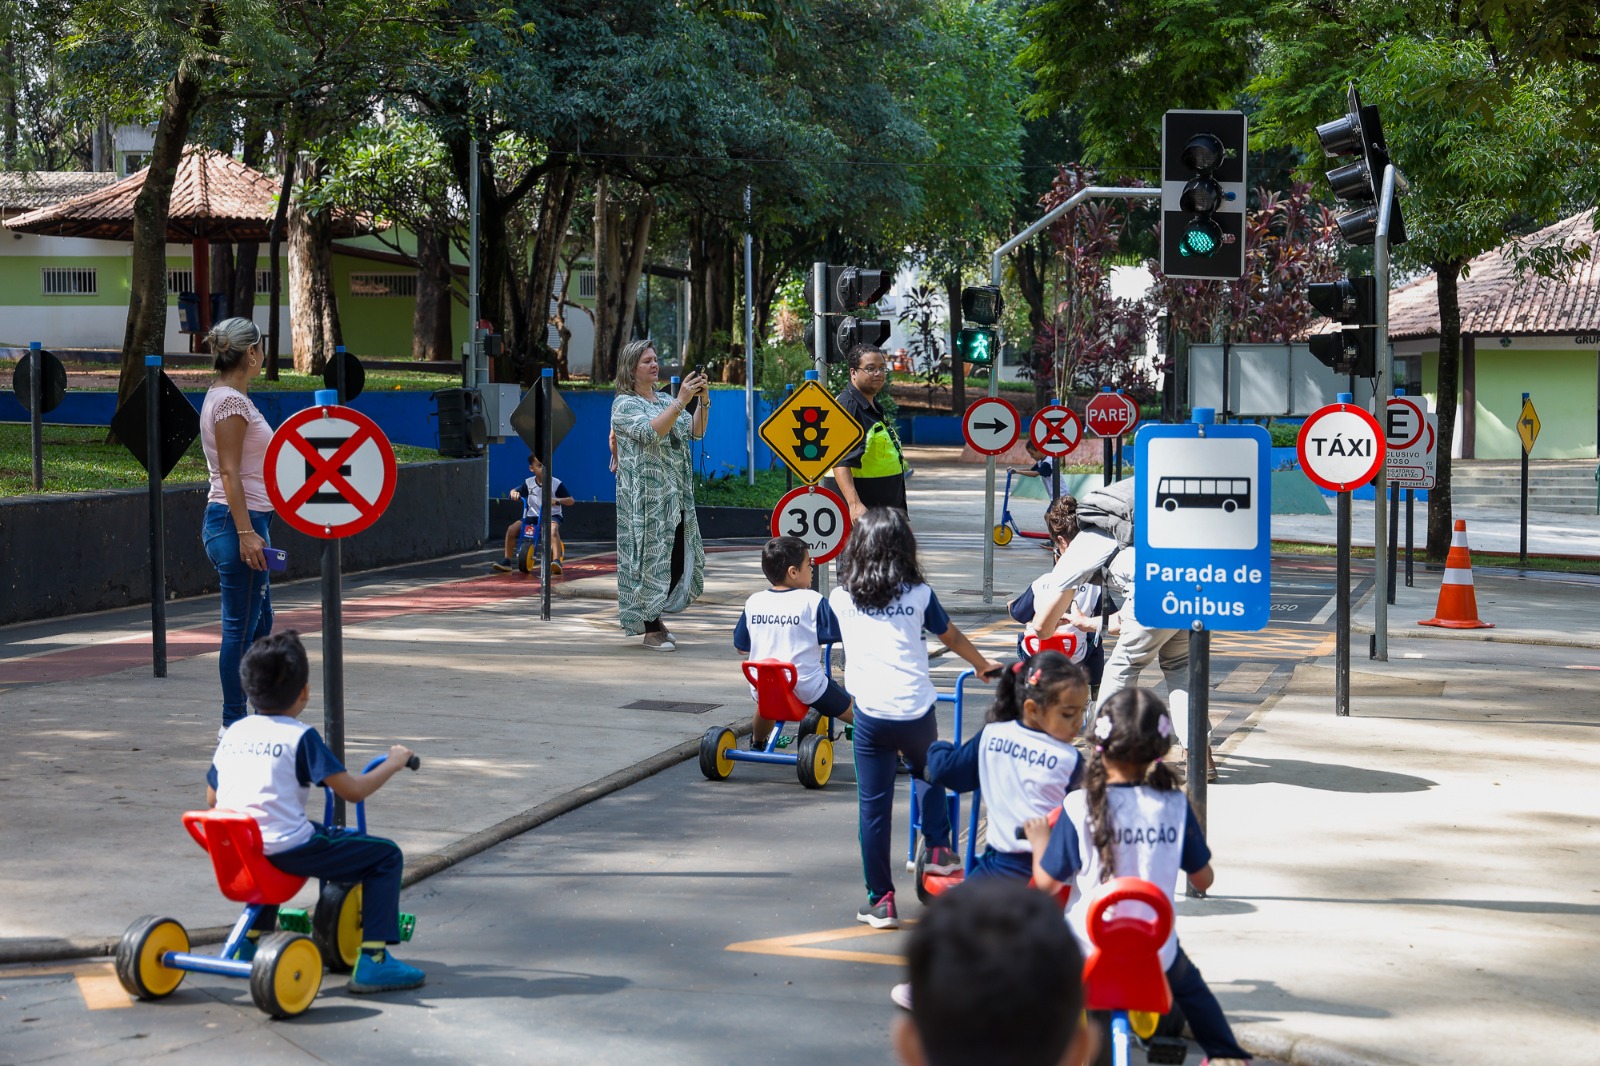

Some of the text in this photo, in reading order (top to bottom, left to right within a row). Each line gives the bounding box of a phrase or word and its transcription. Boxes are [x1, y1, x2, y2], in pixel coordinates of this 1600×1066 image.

[1089, 409, 1127, 422] PARE
[1387, 410, 1409, 438] E
[1311, 433, 1371, 457] TÁXI
[787, 507, 837, 537] 30
[1145, 563, 1262, 584] Parada de
[1161, 591, 1245, 616] Ônibus
[1270, 604, 1298, 612] OSO
[751, 614, 800, 627] EDUCAÇÃO
[988, 736, 1058, 770] EDUCAÇÃO
[1112, 822, 1177, 849] UCAÇÃO
